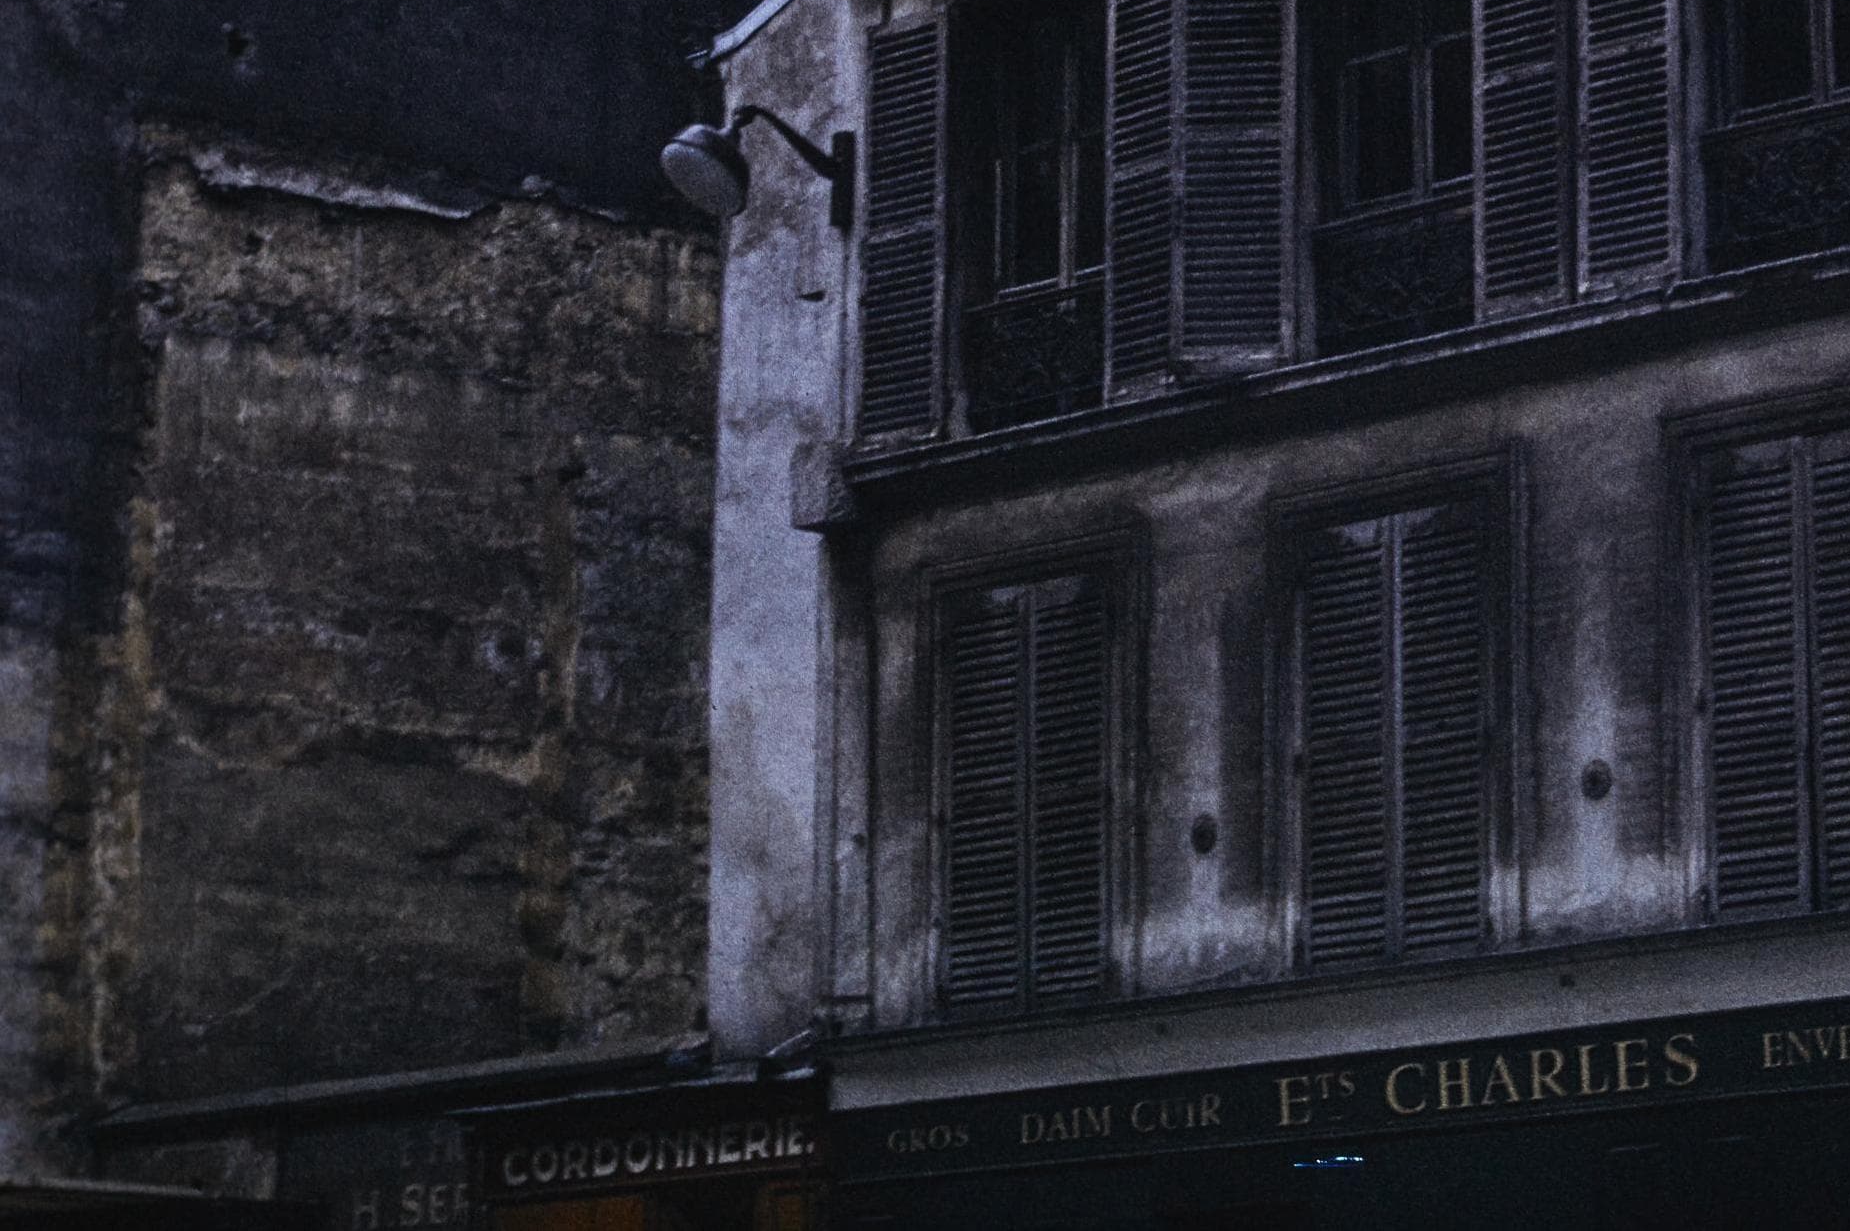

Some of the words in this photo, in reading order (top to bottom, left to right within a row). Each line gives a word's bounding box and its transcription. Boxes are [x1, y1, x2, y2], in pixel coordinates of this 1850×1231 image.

[887, 1125, 970, 1154] GROS
[1020, 1104, 1113, 1145] DAIM
[1131, 1093, 1222, 1133] CUIR
[1385, 1033, 1700, 1115] CHARLES
